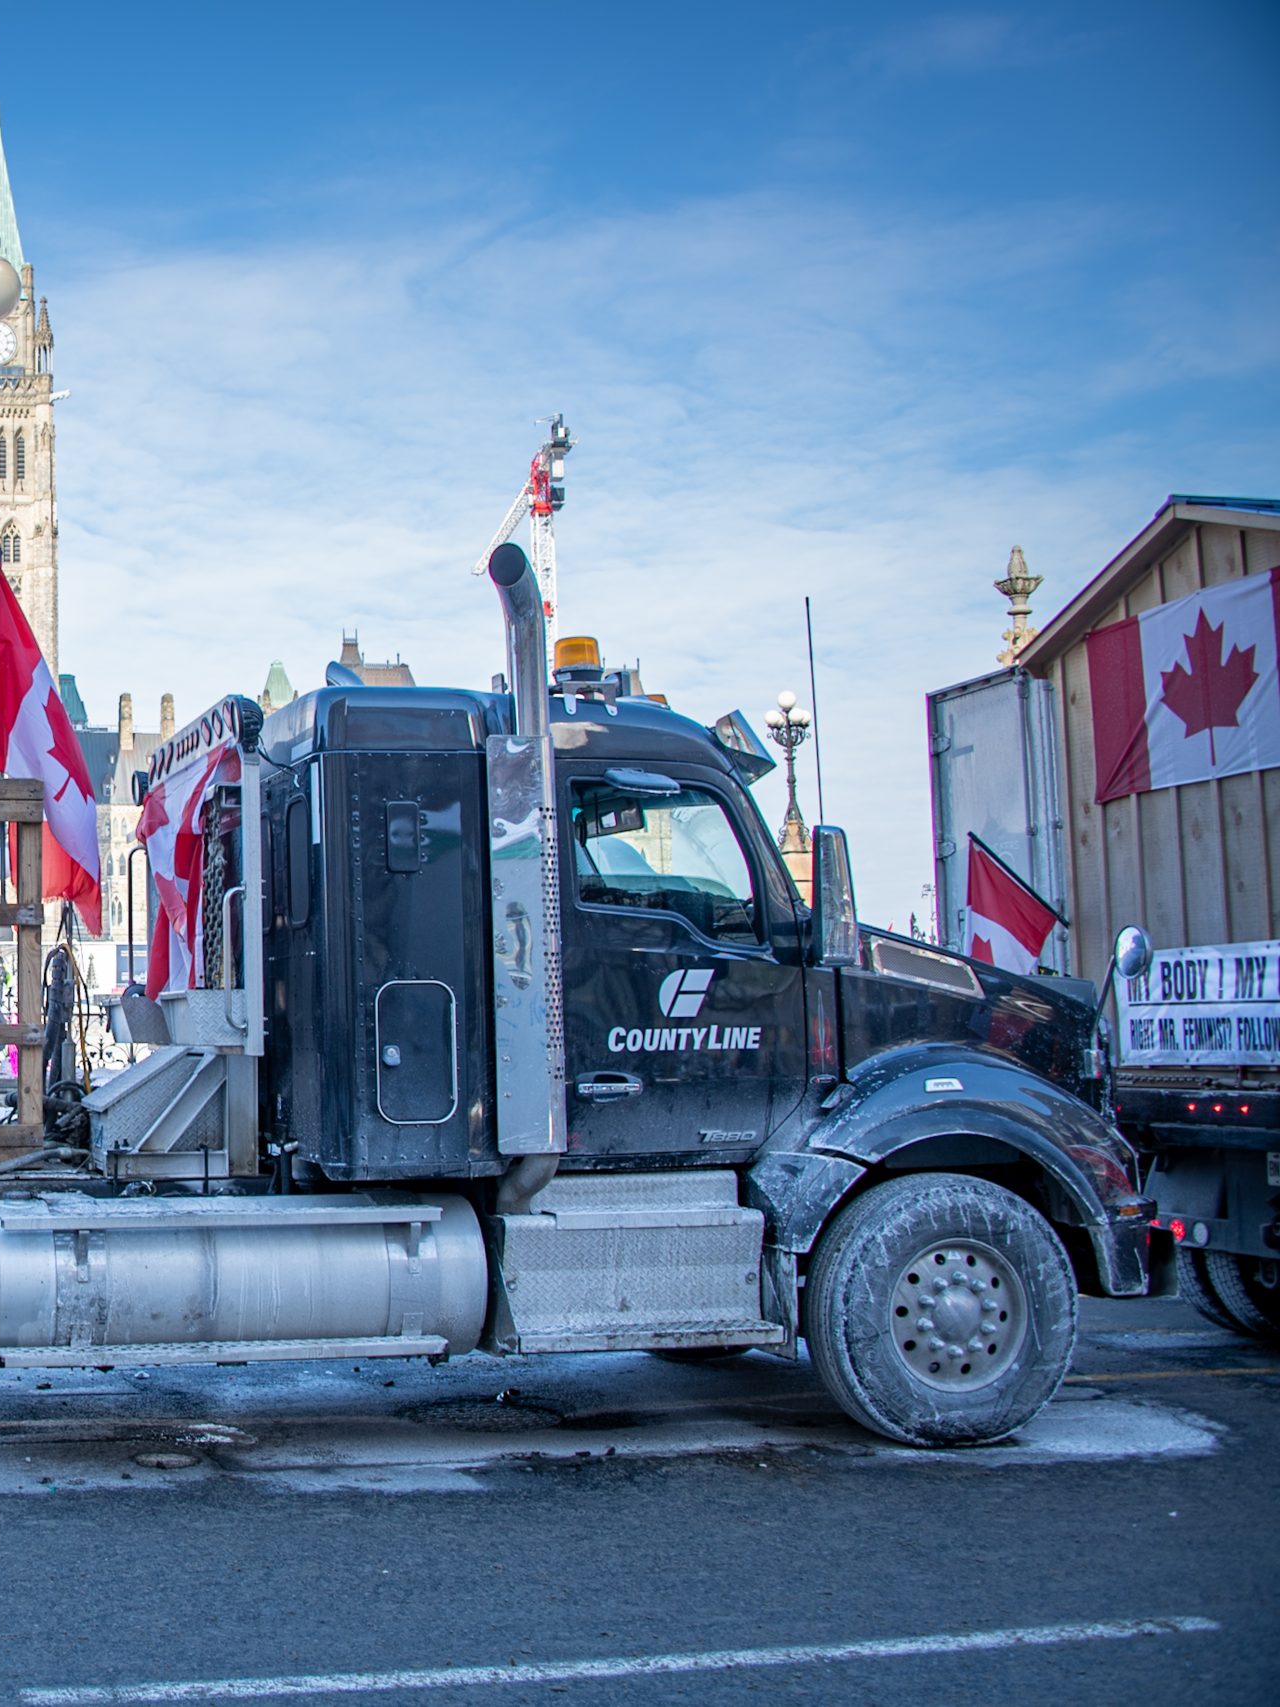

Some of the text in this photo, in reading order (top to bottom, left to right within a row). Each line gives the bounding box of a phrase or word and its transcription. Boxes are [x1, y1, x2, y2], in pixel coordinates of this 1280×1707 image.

[1160, 959, 1209, 1001] BODY
[1234, 956, 1267, 999] MY
[1130, 1018, 1154, 1050] RIGHT
[1158, 1018, 1179, 1050] MR.
[1183, 1017, 1232, 1051] FEMINIST?
